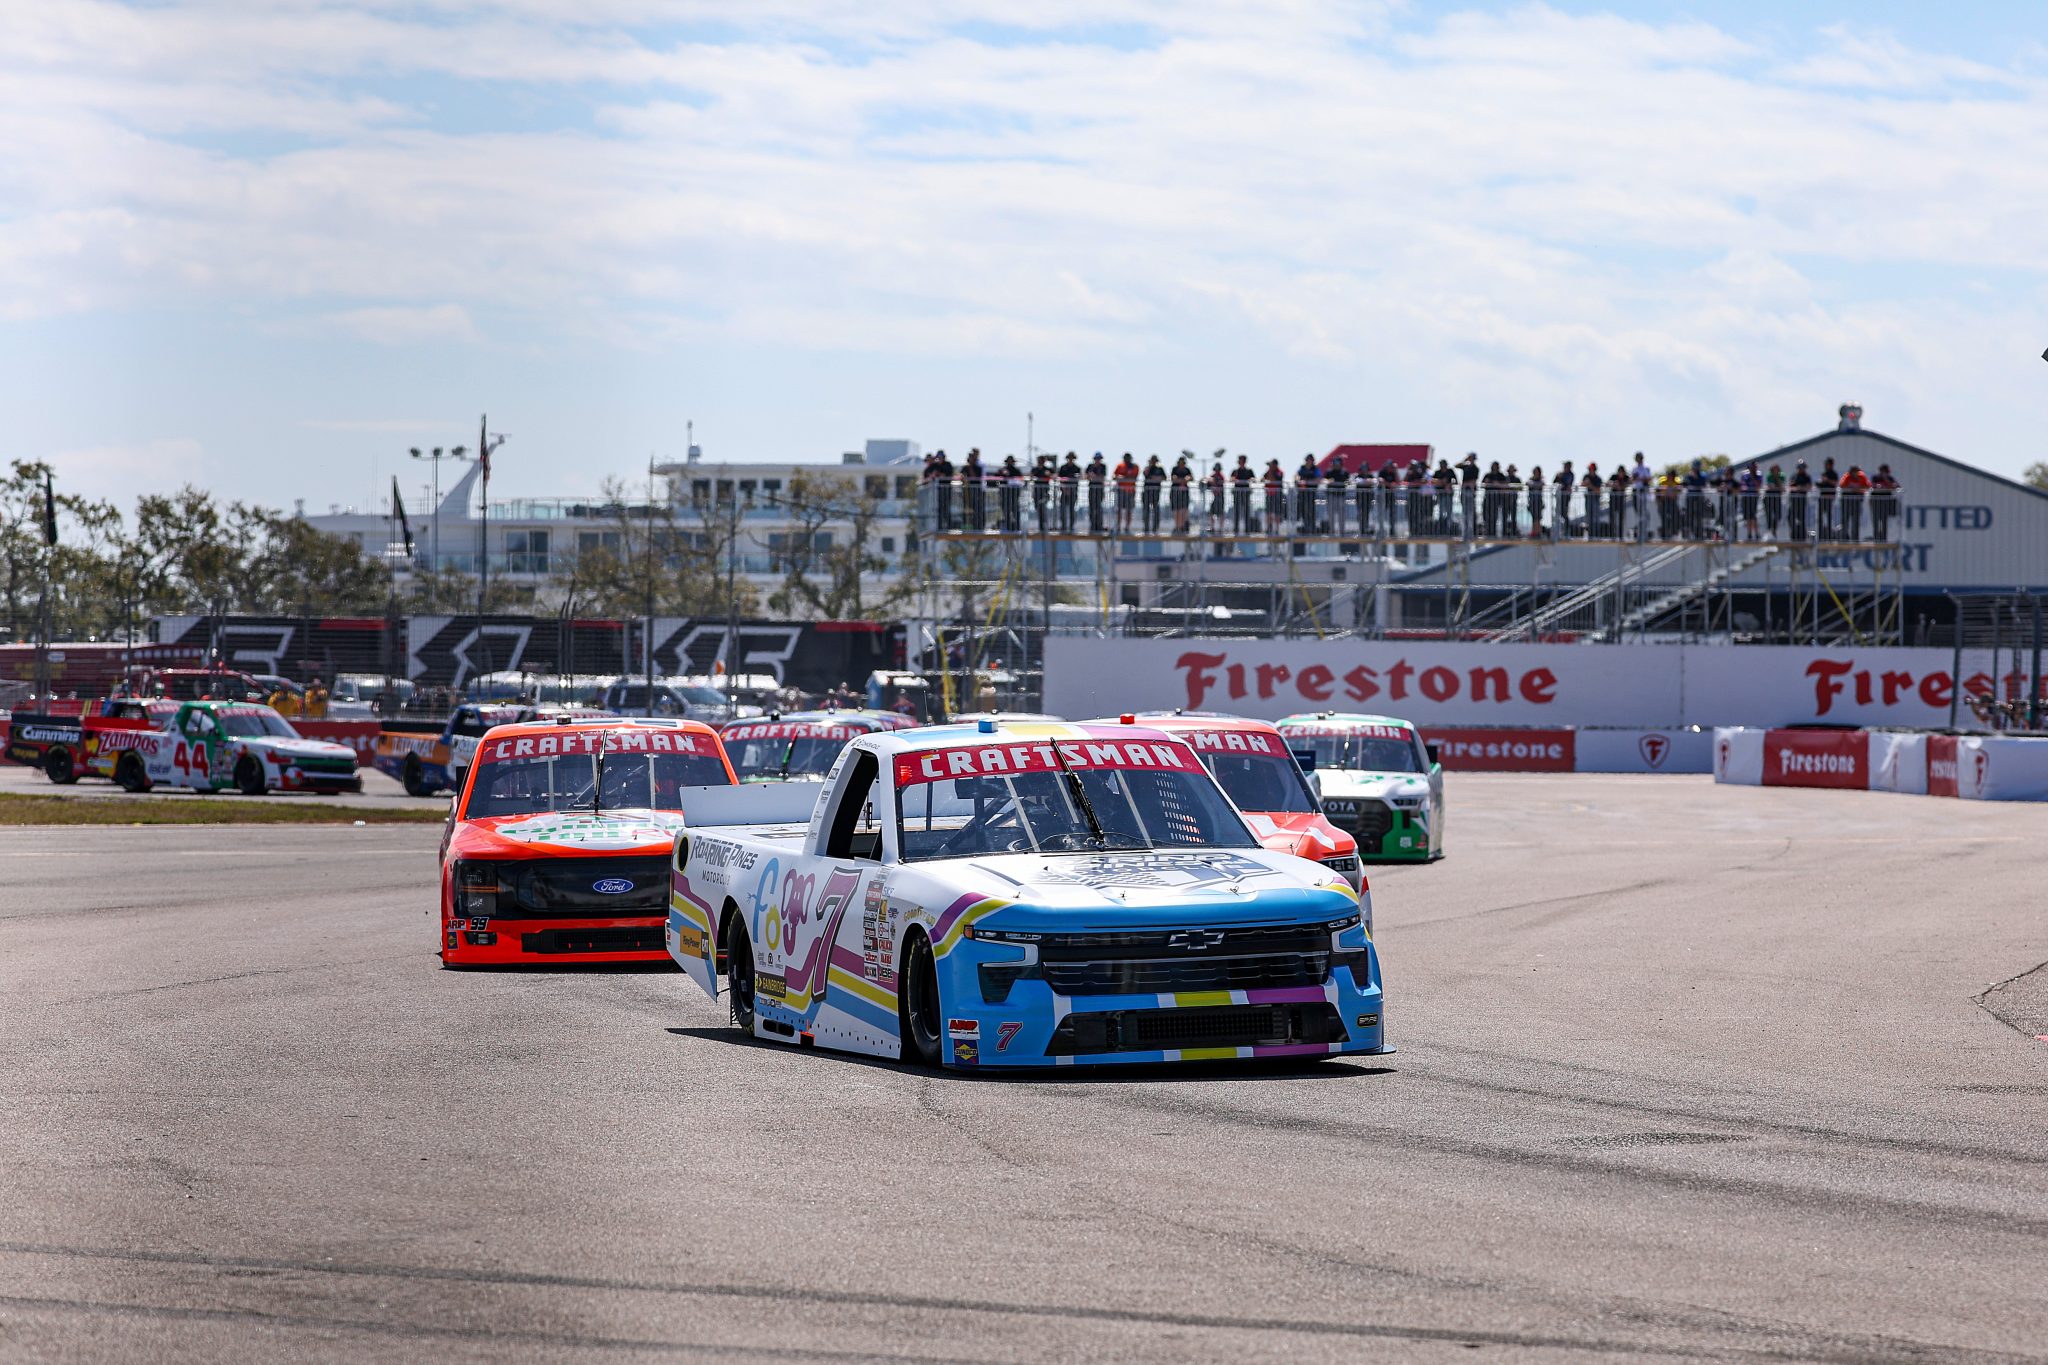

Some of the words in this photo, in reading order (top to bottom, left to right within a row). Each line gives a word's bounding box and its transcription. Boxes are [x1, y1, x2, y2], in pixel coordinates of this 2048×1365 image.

[1174, 651, 1559, 711] Firestone
[22, 725, 80, 743] Cummins
[725, 723, 862, 741] CRAFTSMAN
[495, 734, 697, 758] CRAFTSMAN
[173, 740, 210, 779] 44
[920, 743, 1184, 778] CRAFTSMAN
[1779, 748, 1855, 776] Firestone
[690, 836, 732, 868] ROARING
[600, 880, 626, 891] Ford
[446, 919, 466, 929] ARP
[470, 917, 489, 931] 99
[811, 865, 863, 1004] 7
[949, 1019, 978, 1030] ARP
[996, 1021, 1023, 1052] 7
